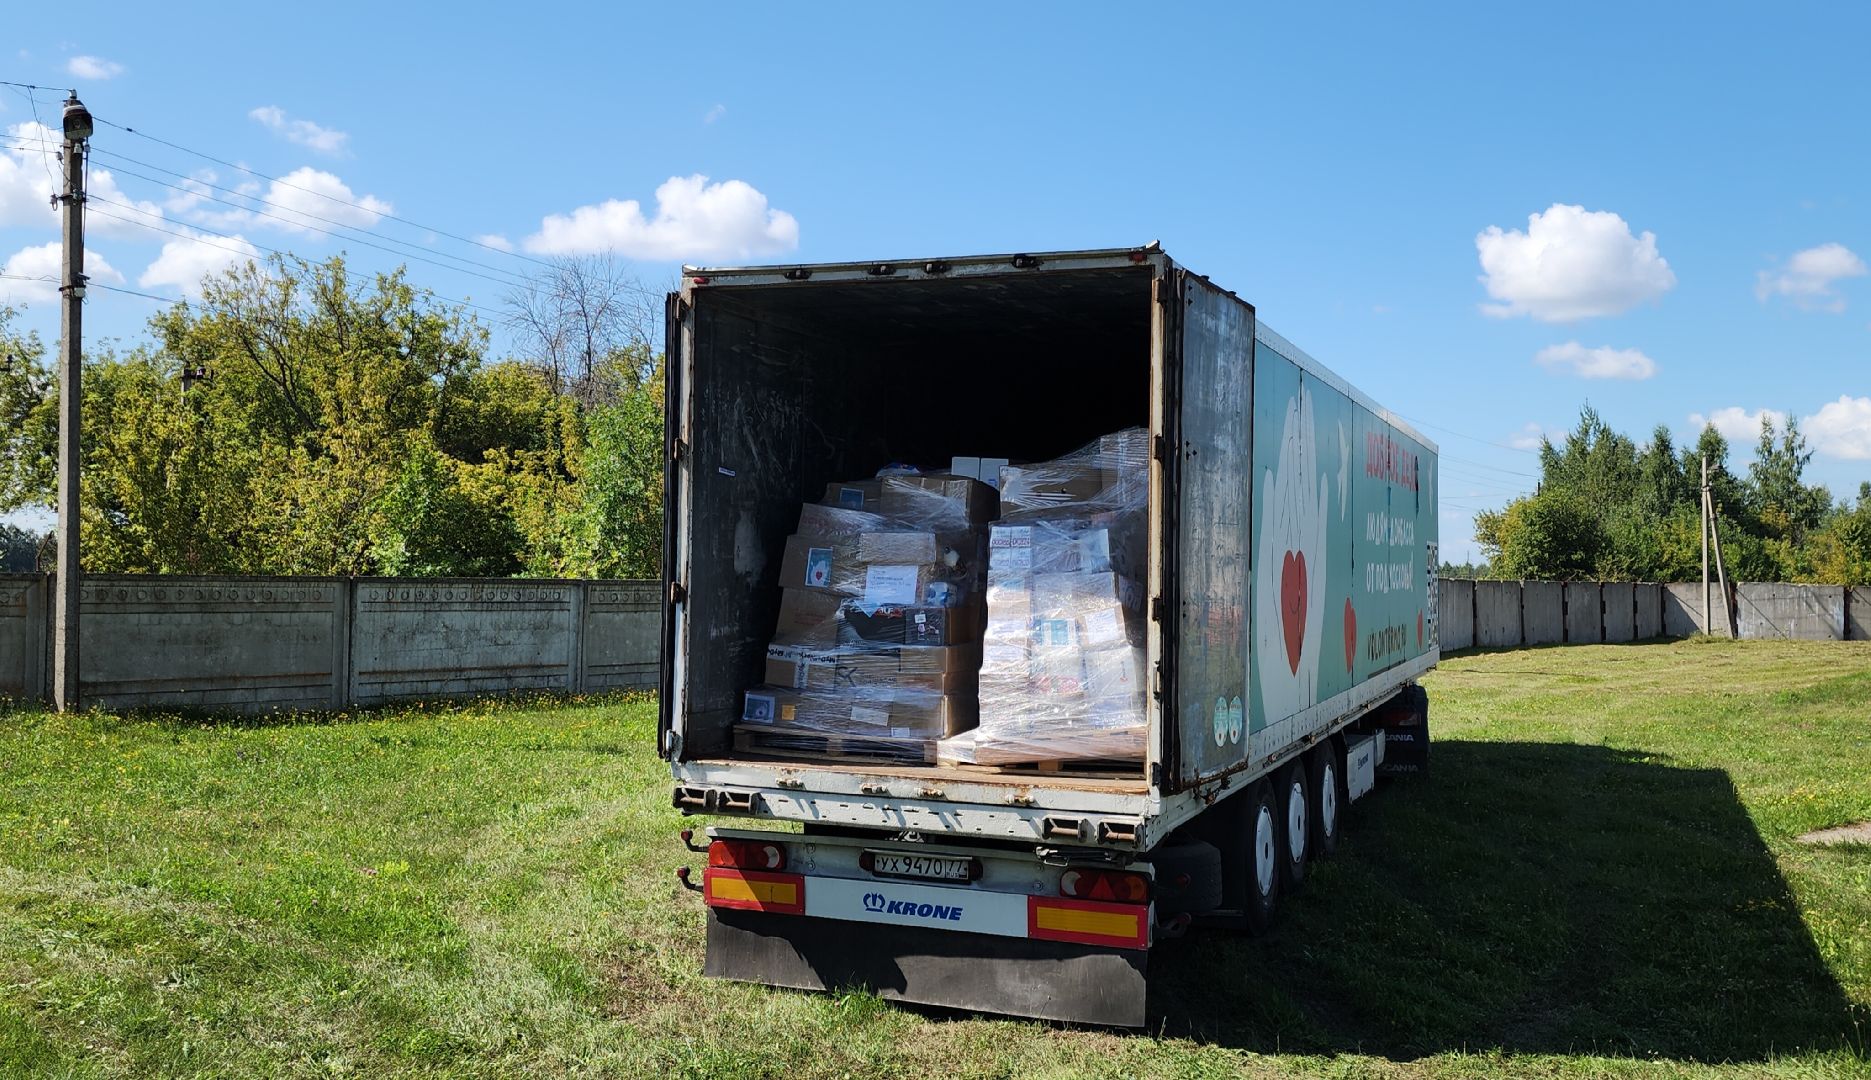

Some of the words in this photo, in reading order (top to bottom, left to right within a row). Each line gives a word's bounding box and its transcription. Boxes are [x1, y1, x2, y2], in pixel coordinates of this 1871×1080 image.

[1366, 562, 1374, 593] ОТ
[1385, 734, 1415, 742] CANIA
[886, 900, 963, 921] KRONE
